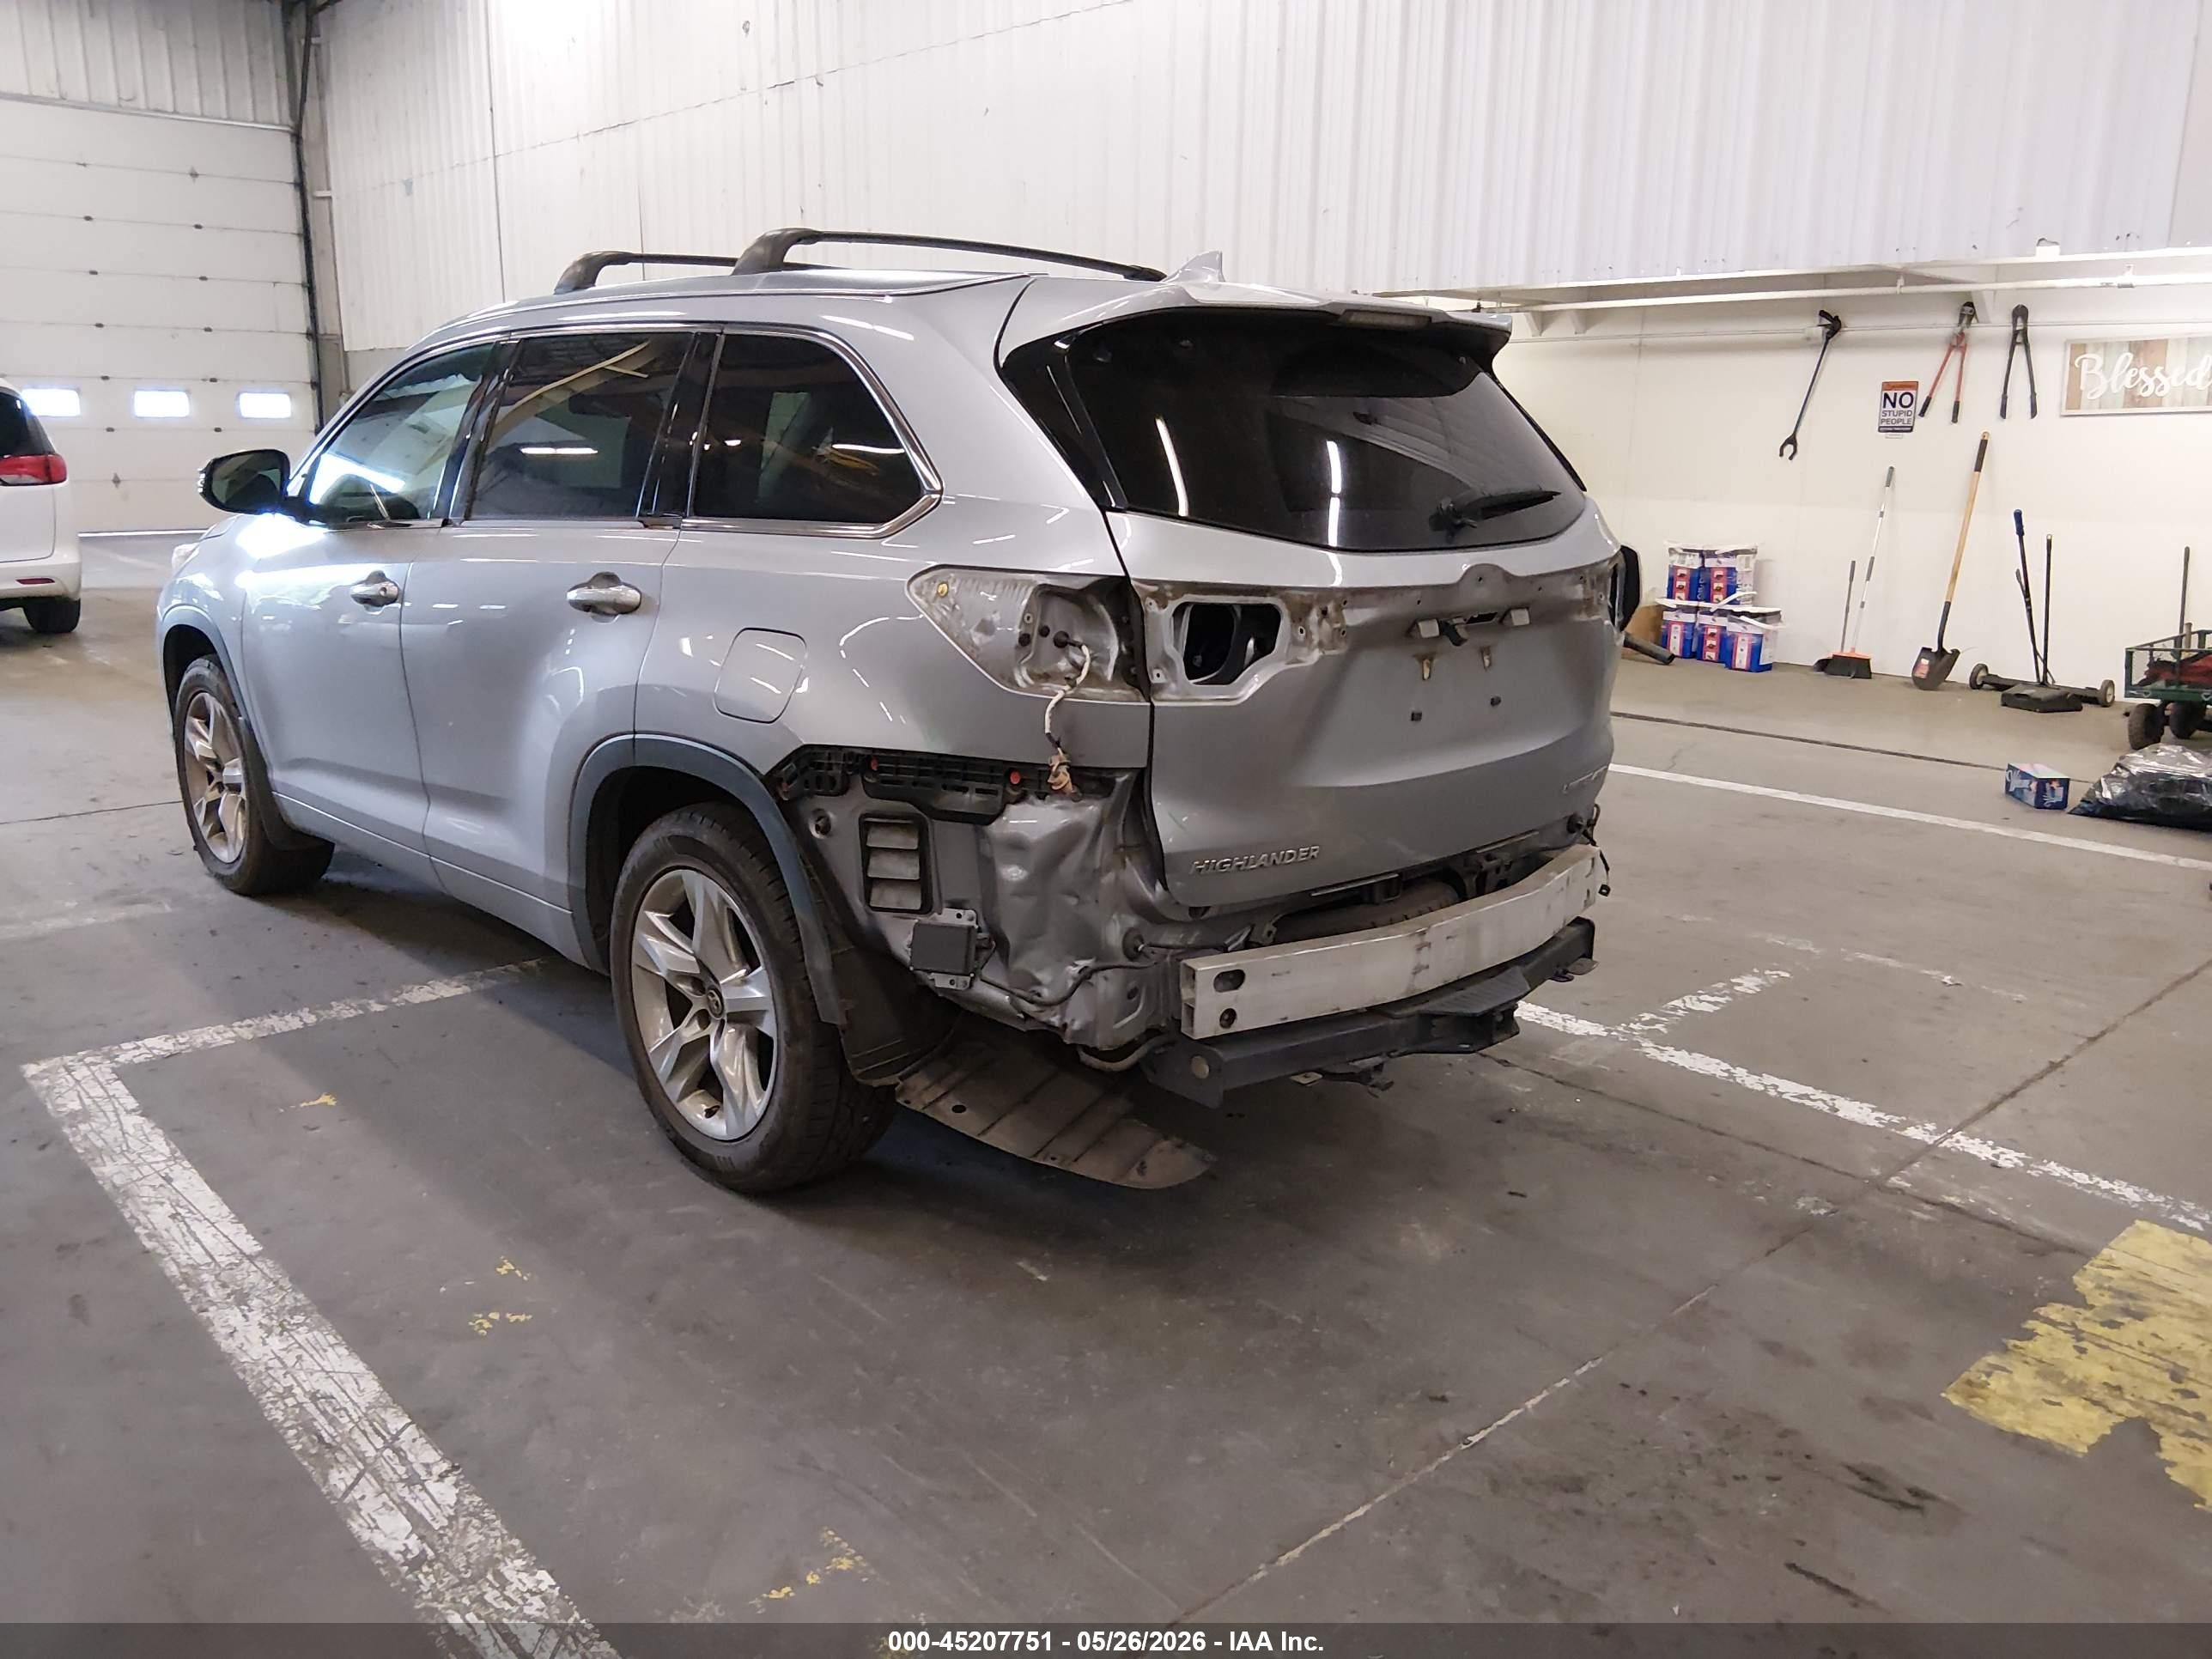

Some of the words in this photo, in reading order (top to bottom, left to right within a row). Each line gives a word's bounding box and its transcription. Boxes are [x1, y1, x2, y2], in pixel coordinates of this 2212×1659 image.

[2075, 352, 2212, 399] Blessed
[1882, 392, 1914, 409] NO
[1189, 845, 1320, 875] HIGHLANDER
